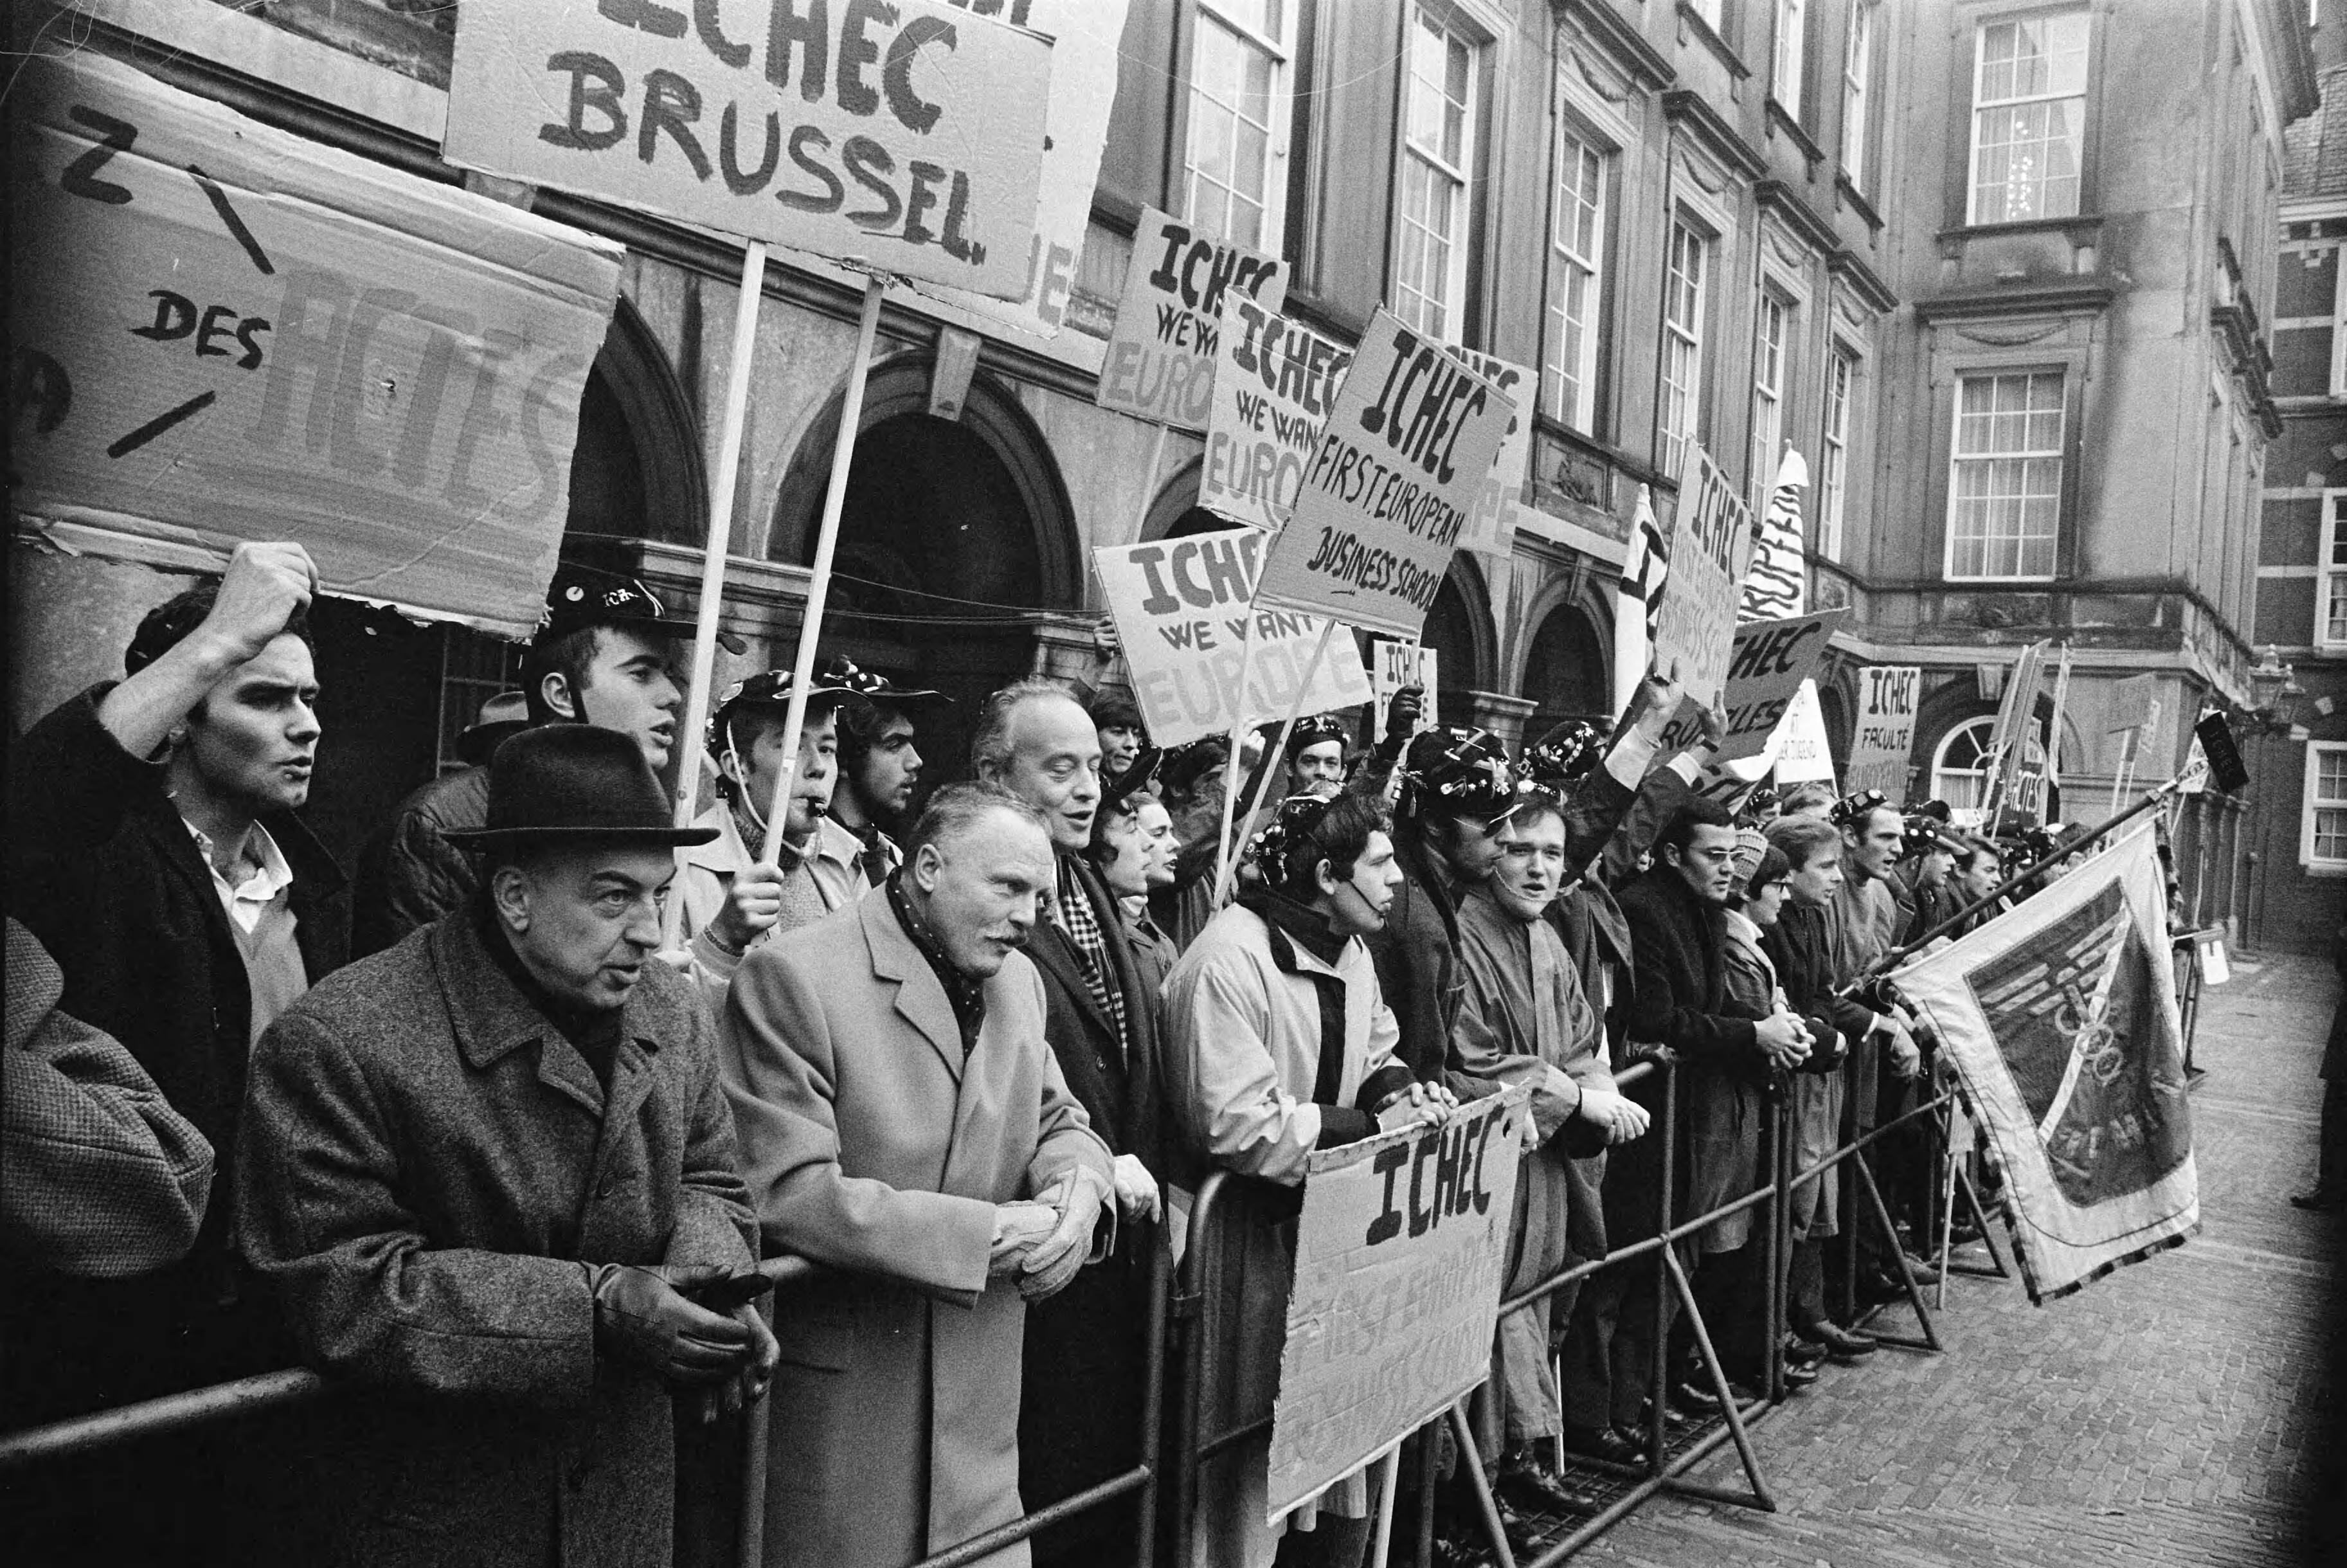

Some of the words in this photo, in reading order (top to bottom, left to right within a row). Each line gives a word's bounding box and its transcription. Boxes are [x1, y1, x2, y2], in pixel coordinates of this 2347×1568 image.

[129, 289, 271, 370] DES
[1106, 341, 1215, 422] EURO
[1360, 329, 1488, 485] ICHEC
[1236, 390, 1269, 432] WE
[1270, 406, 1319, 452] WAN
[1207, 431, 1302, 528] EURO
[1373, 473, 1466, 547] EUROPEAN
[1307, 526, 1398, 591] BUSINESS
[1692, 458, 1745, 586] ICHEC
[1129, 534, 1263, 615] ICH
[1158, 620, 1218, 651] WE
[1386, 645, 1425, 687] ICHC
[1726, 620, 1822, 681] HEC
[1868, 669, 1916, 716] ICHEC
[1366, 1104, 1505, 1246] ICHEC
